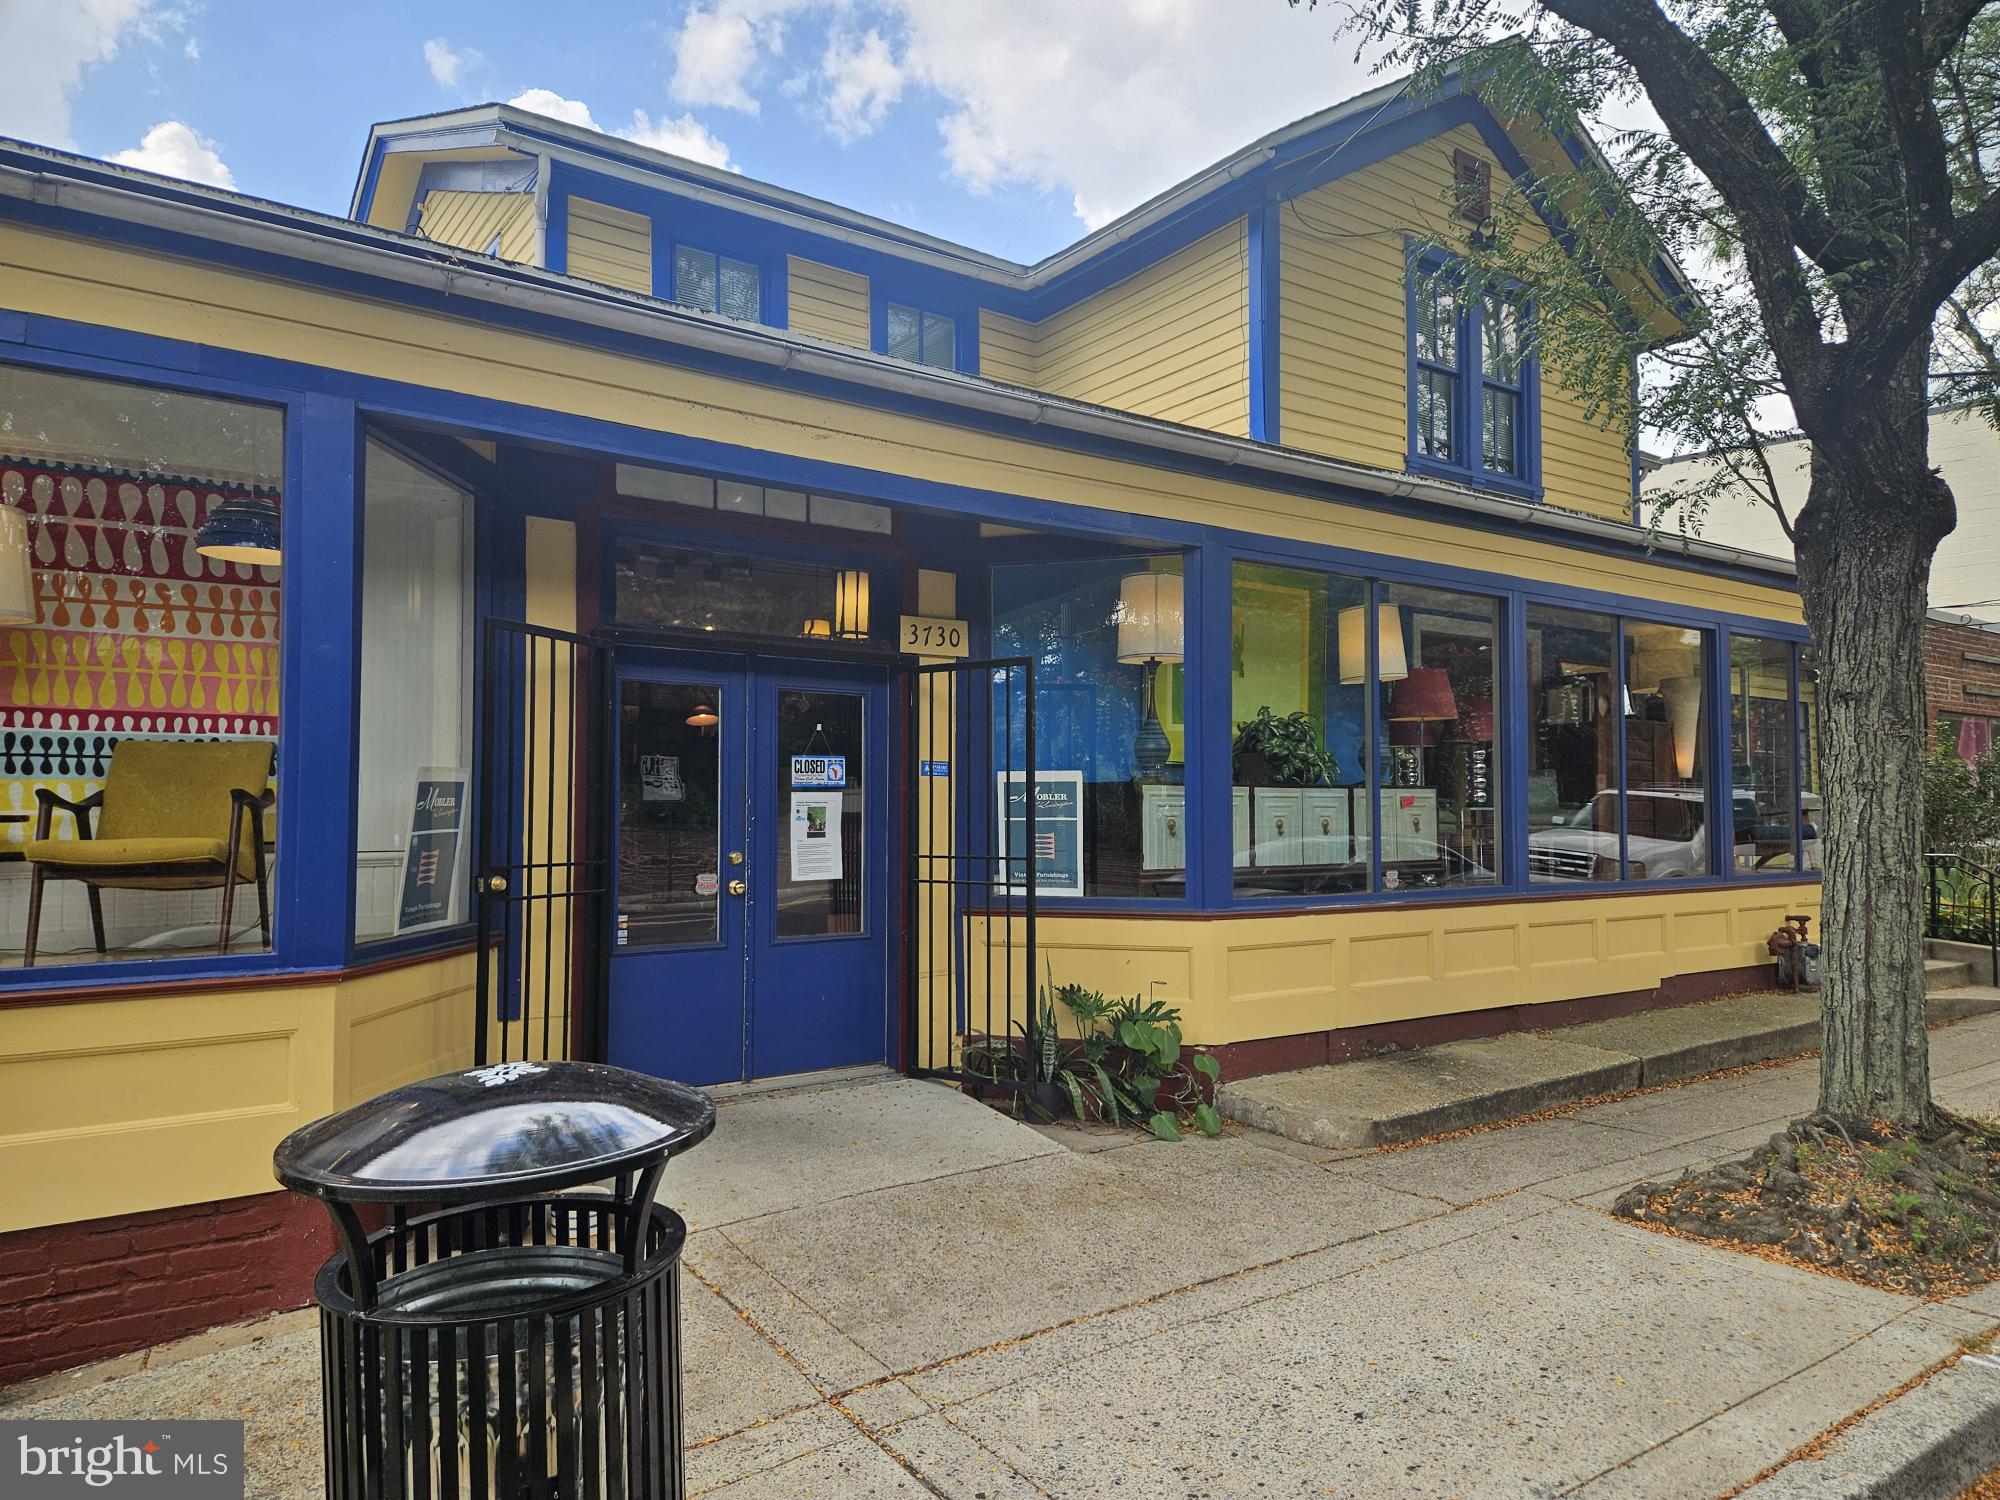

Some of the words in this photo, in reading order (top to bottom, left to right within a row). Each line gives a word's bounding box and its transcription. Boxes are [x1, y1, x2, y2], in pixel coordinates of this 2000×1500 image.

[908, 624, 960, 647] 3730
[794, 759, 825, 773] CLOSED
[417, 786, 455, 811] MOBLER
